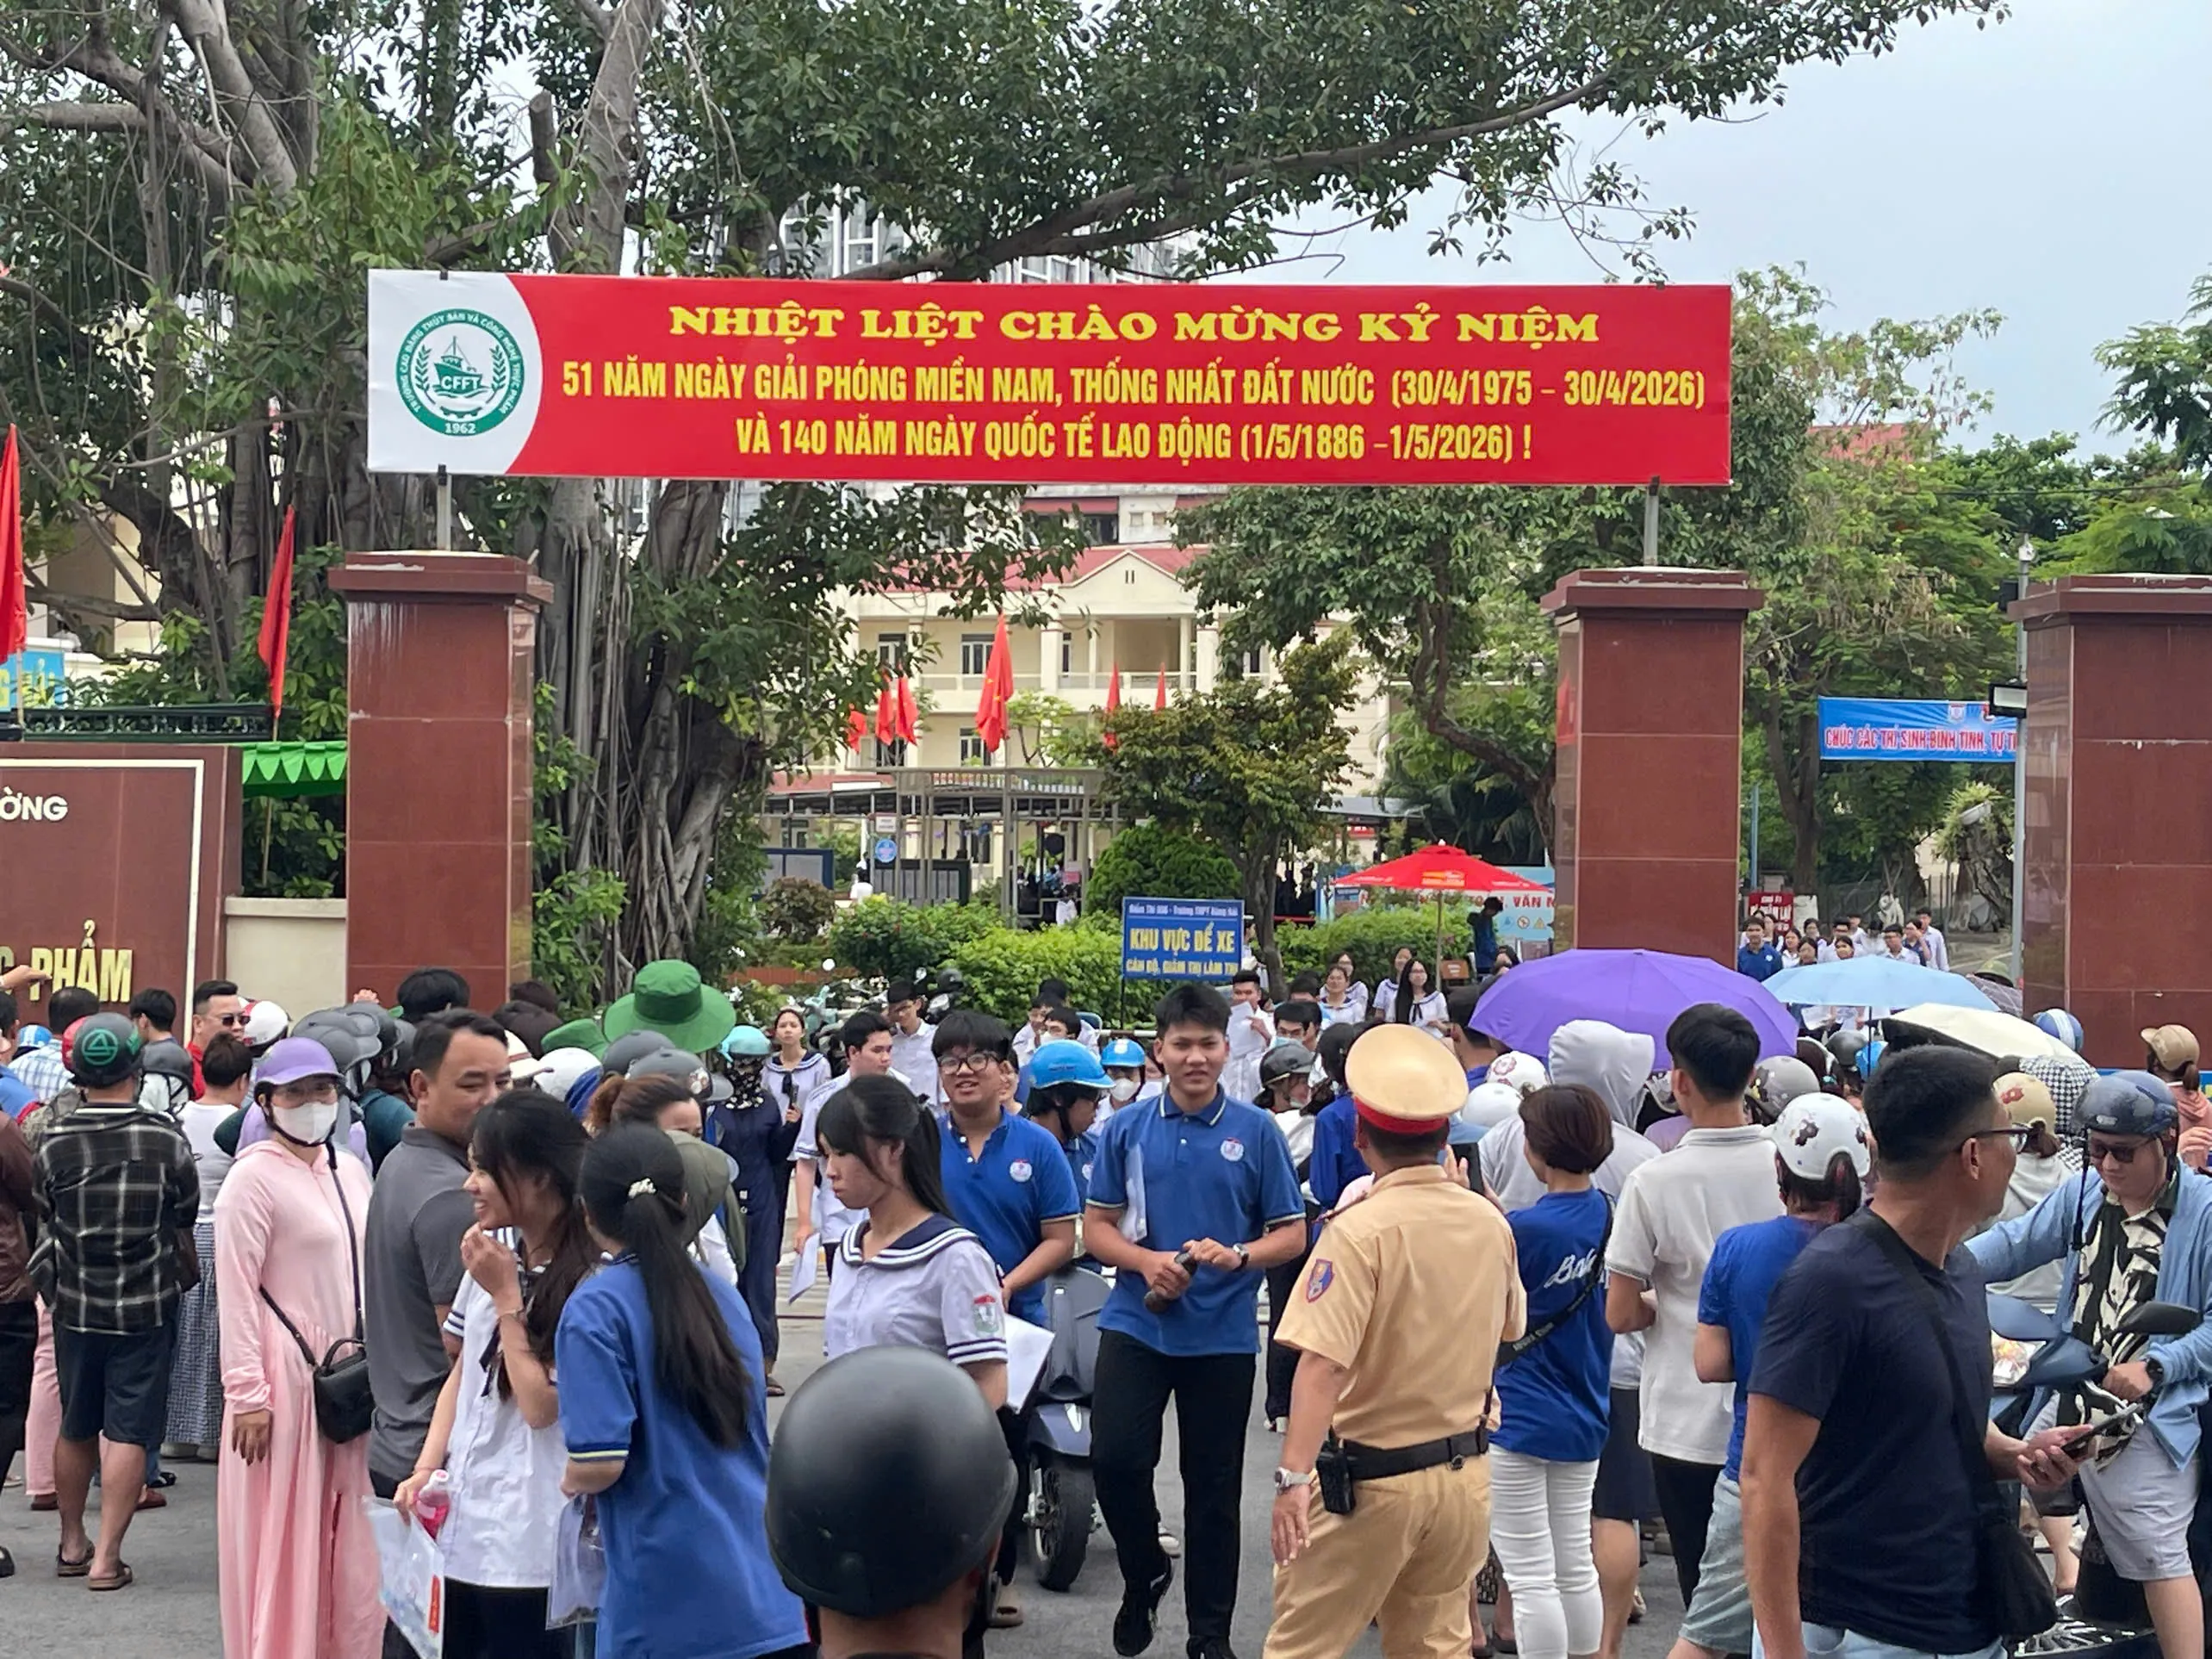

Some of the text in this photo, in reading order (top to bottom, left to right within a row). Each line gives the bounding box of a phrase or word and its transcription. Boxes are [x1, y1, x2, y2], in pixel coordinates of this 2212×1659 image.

[668, 300, 1600, 350] NHIỆT LIỆT CHÀO MỪNG KỶ NIỆM
[441, 376, 482, 391] CFFT
[562, 361, 592, 396] 51
[603, 354, 667, 398] NĂM
[674, 355, 747, 400] NGÀY
[754, 352, 808, 401] GIẢI
[816, 358, 907, 401] PHÓNG
[915, 355, 985, 402] MIỀN
[992, 367, 1062, 407] NAM,
[1070, 355, 1158, 404] THỐNG
[1165, 356, 1236, 404] NHẤT
[1242, 357, 1295, 404] ĐẤT
[1302, 362, 1375, 405] NƯỚC
[1391, 369, 1532, 409] (30/4/1975
[1563, 370, 1705, 409] 30/4/2026)
[444, 421, 476, 434] 1962
[736, 411, 771, 454] VÀ
[779, 419, 827, 455] 140
[835, 413, 898, 456] NĂM
[905, 413, 977, 457] NGÀY
[985, 410, 1055, 461] QUỐC
[1063, 411, 1096, 457] TẾ
[1102, 422, 1151, 458] LAO
[1158, 415, 1232, 466] ĐỘNG
[1240, 423, 1365, 462] (1/5/1886
[1130, 928, 1159, 951] KHU
[1162, 927, 1190, 956] VỰC
[1216, 930, 1235, 954] XE
